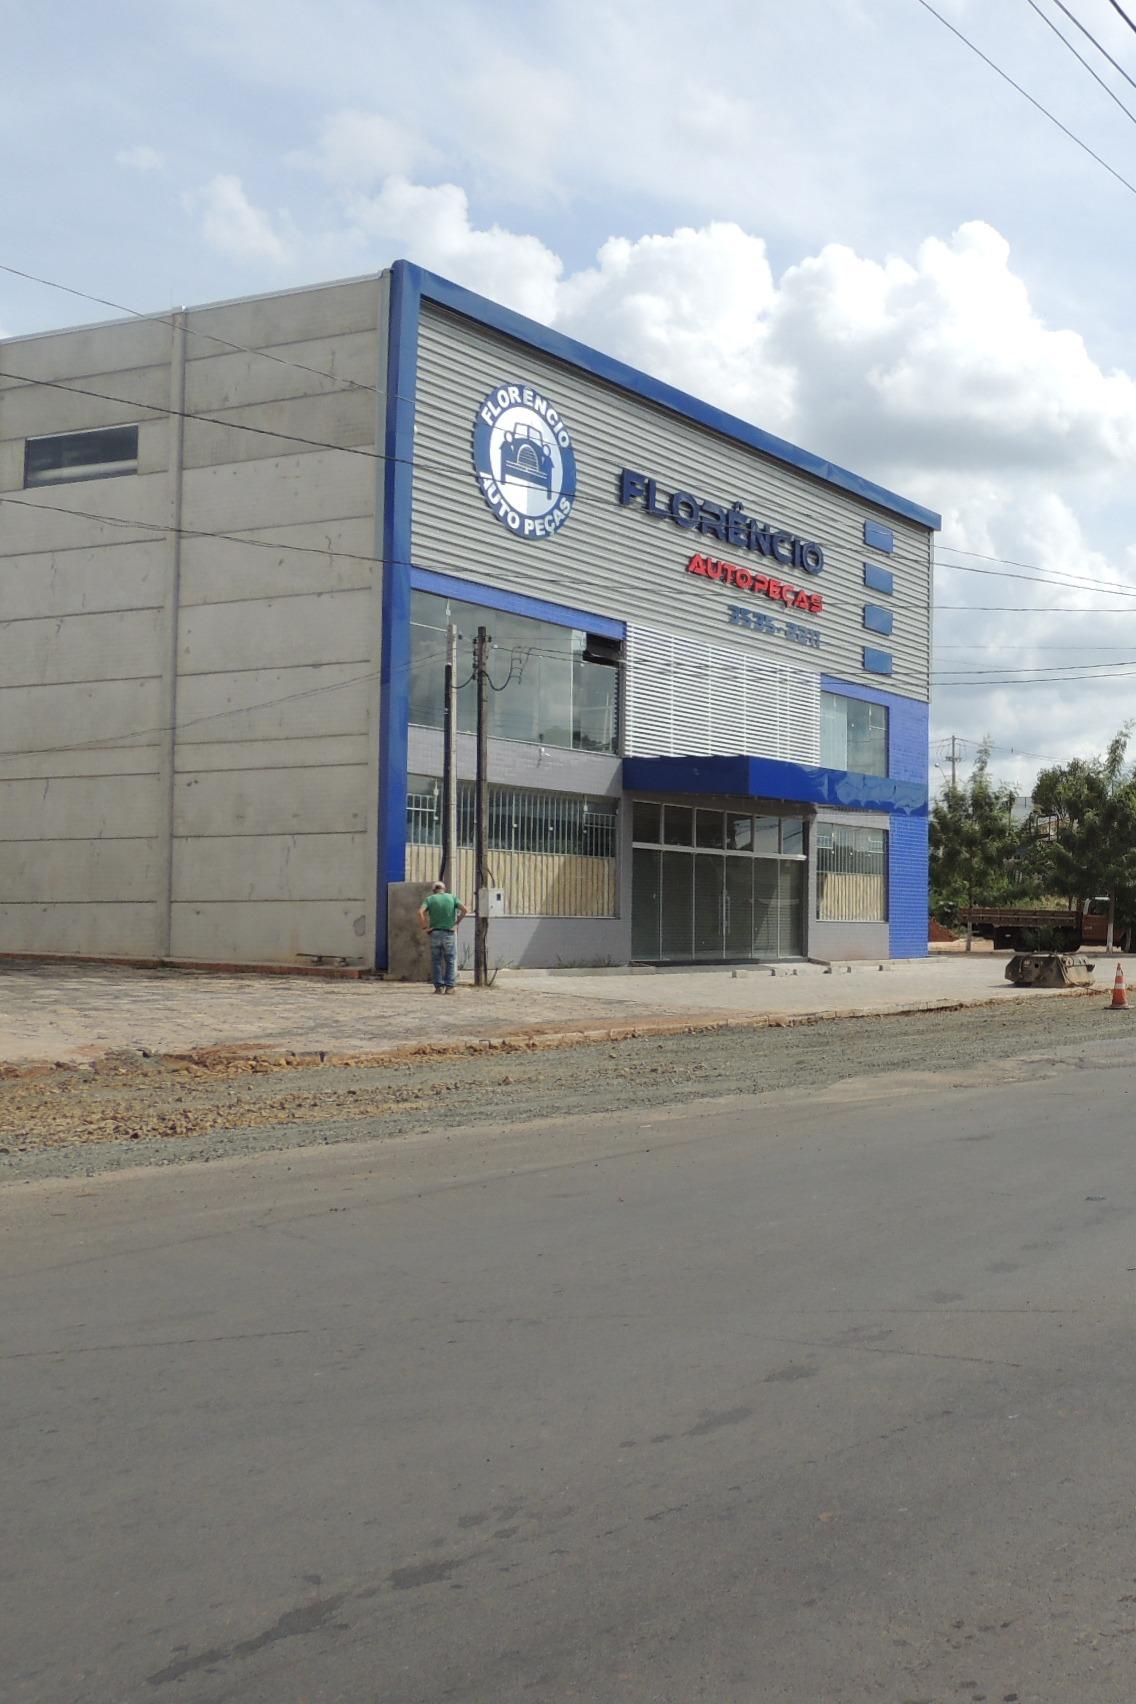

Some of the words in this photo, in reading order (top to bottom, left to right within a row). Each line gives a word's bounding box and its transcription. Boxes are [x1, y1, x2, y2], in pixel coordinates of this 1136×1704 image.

[479, 471, 520, 529] AUTO
[524, 497, 571, 536] PEÇAS
[620, 468, 824, 575] FLORÊNCIO
[686, 552, 824, 613] AUTOPEÇAS
